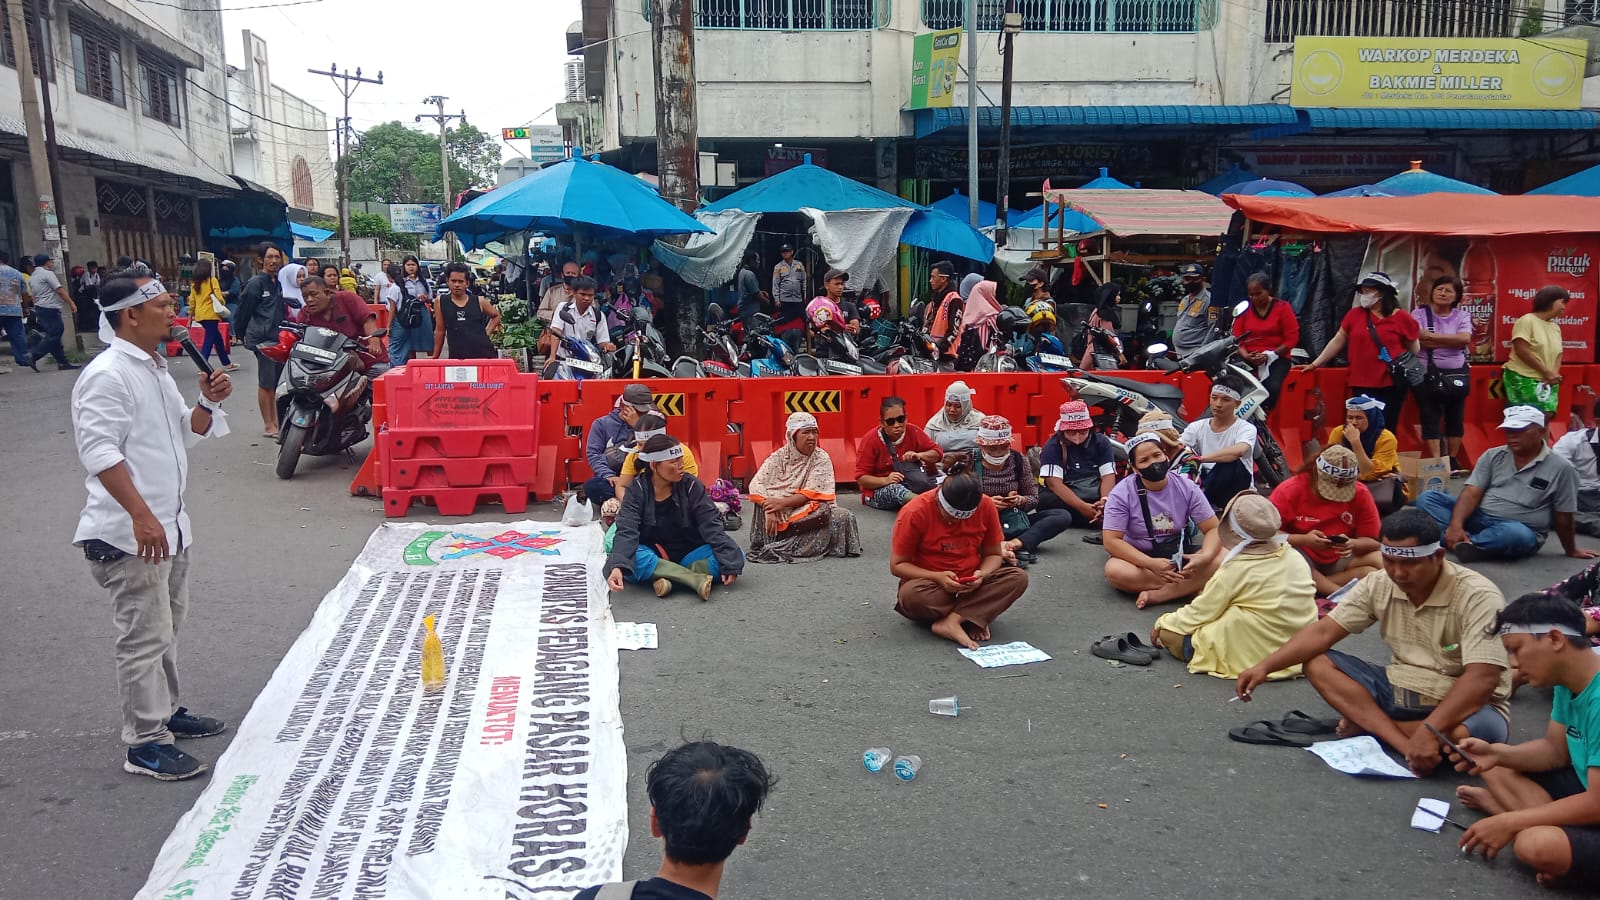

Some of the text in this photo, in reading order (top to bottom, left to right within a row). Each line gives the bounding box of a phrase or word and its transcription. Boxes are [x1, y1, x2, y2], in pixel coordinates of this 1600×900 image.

[1359, 48, 1520, 63] WARKOP MERDEKA
[1432, 64, 1441, 74] &
[1369, 76, 1502, 90] BAKMIE MILLER
[1547, 253, 1591, 272] pucuk
[1553, 266, 1586, 275] HARUM
[1116, 388, 1140, 400] POLISI
[1235, 398, 1256, 418] TROLI
[1322, 462, 1357, 478] KP2H
[1384, 546, 1416, 558] KP2H
[507, 563, 590, 881] KOMUNITAS PEDAGANG PASAR HORAS
